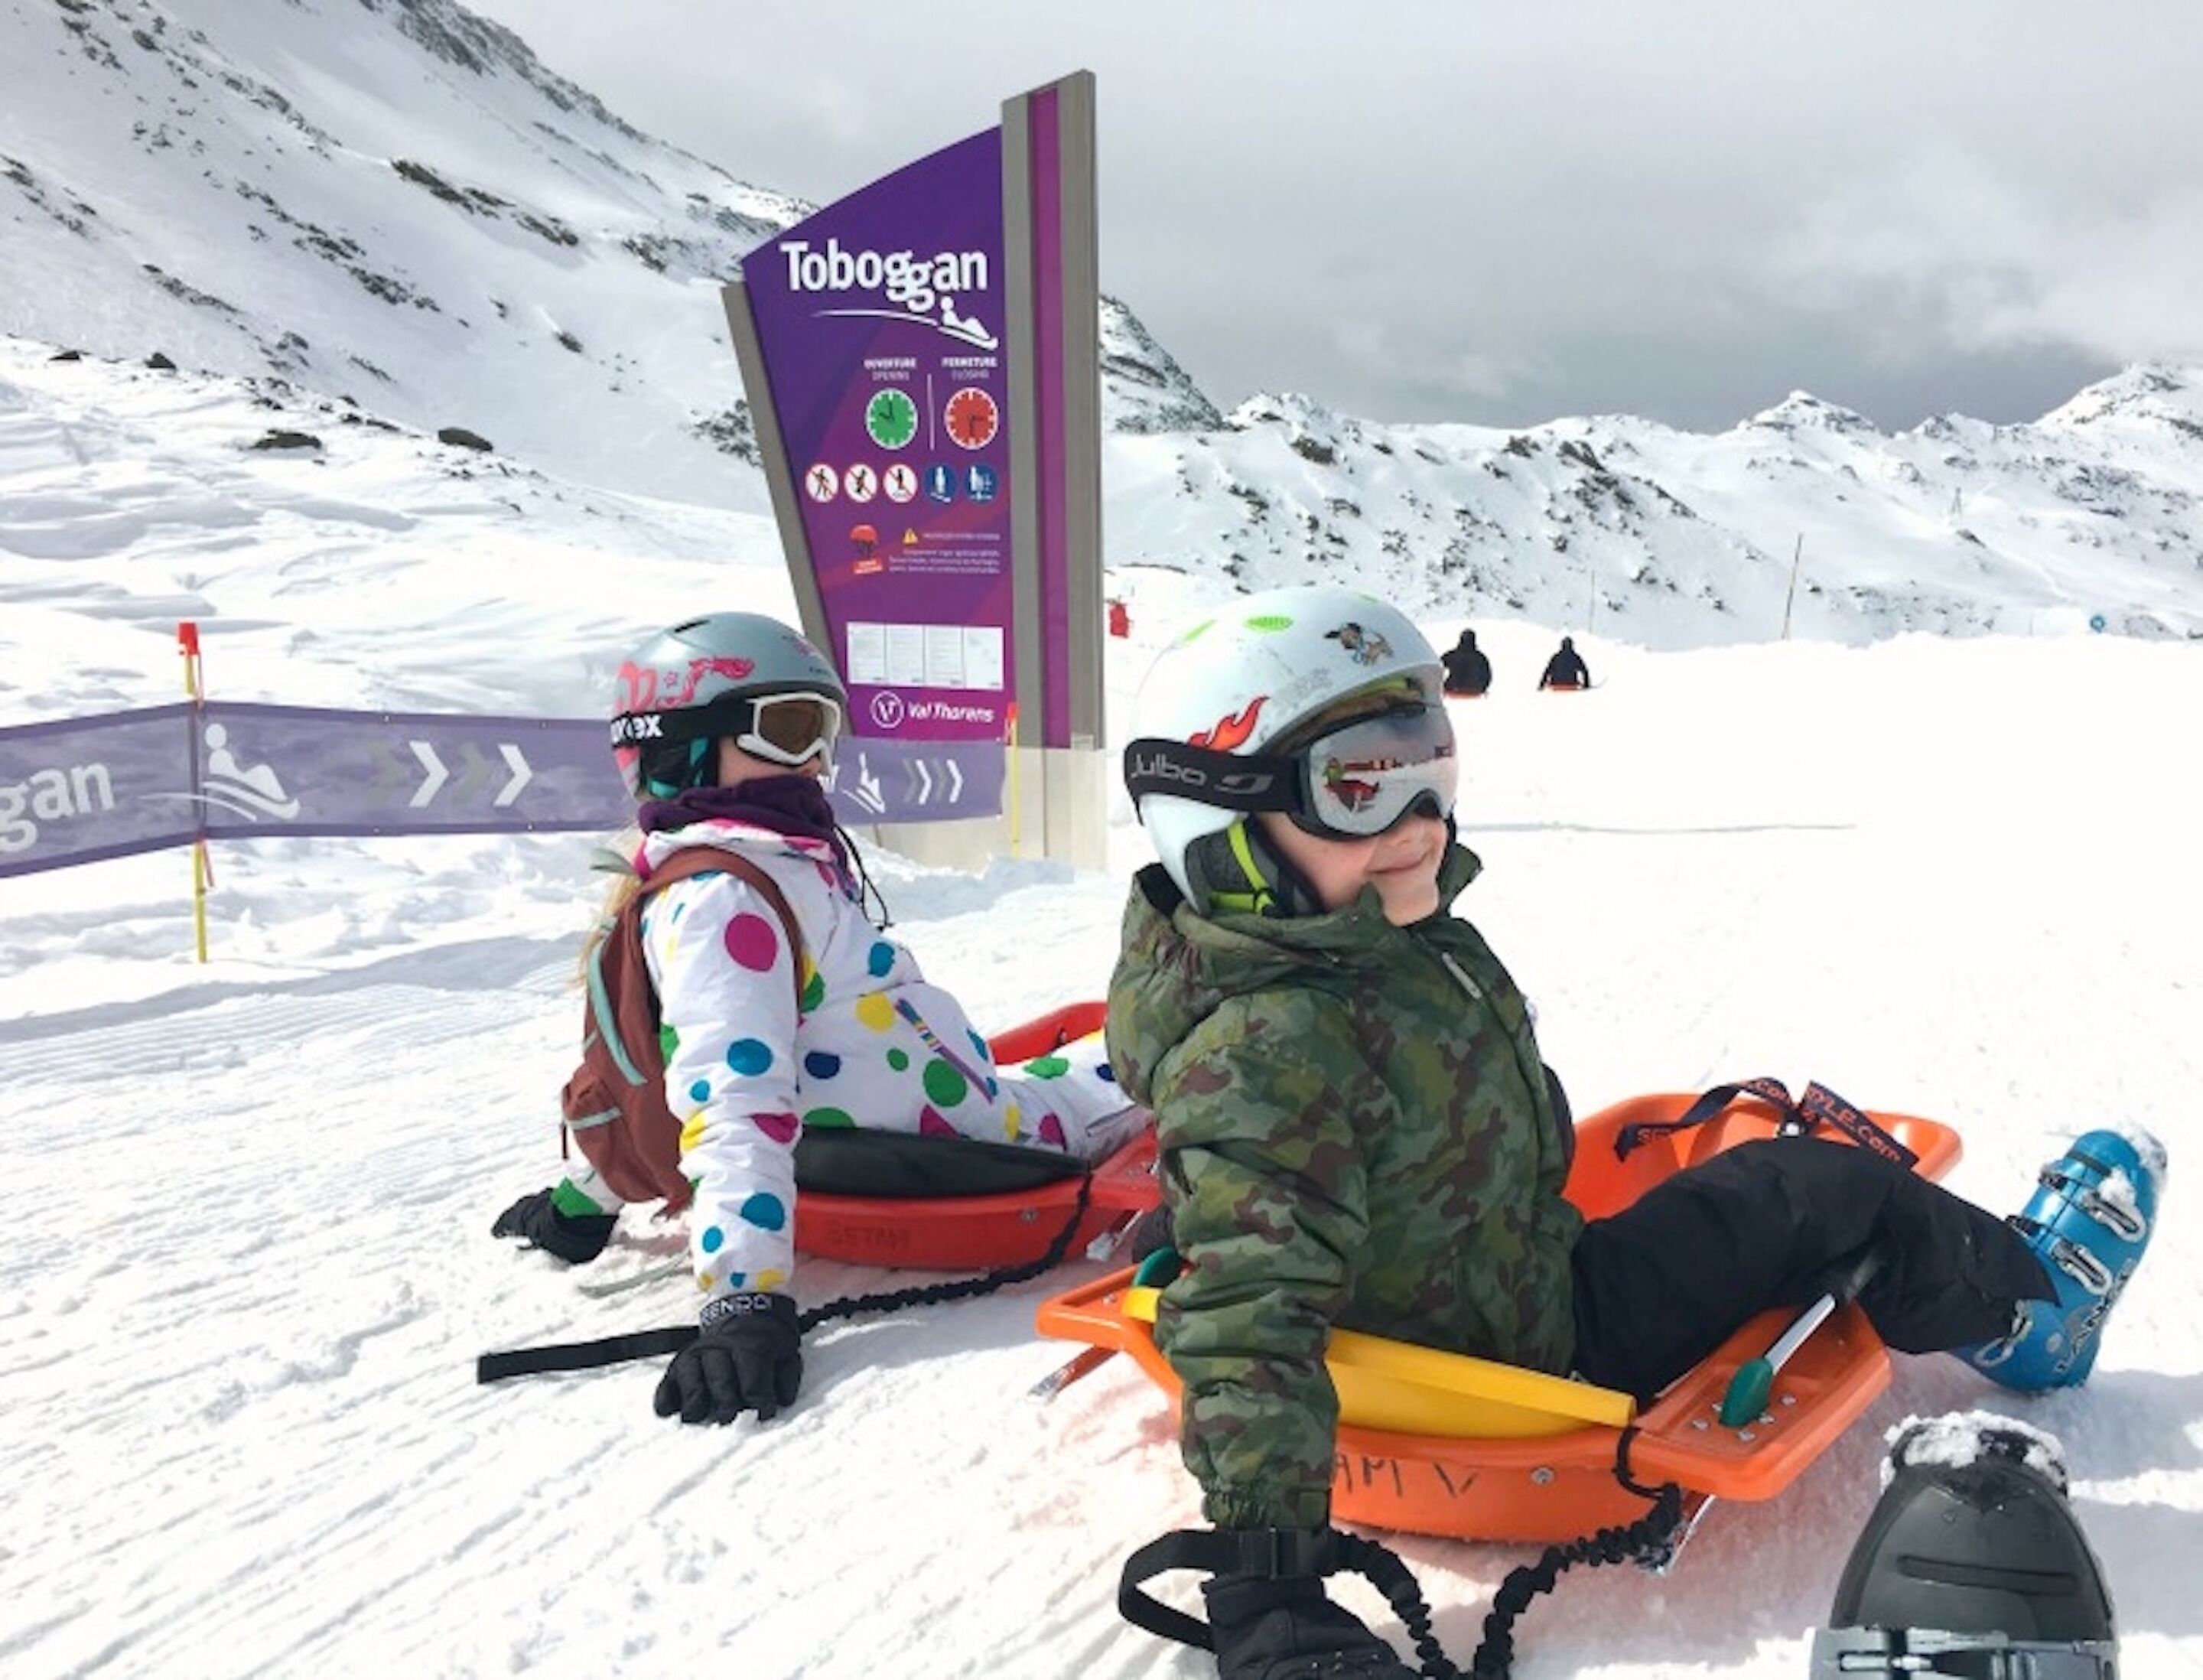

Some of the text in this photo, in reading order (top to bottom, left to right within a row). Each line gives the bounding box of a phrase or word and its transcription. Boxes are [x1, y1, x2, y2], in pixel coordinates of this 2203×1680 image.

[779, 237, 988, 313] Toboggan
[908, 702, 994, 723] Val Thorens
